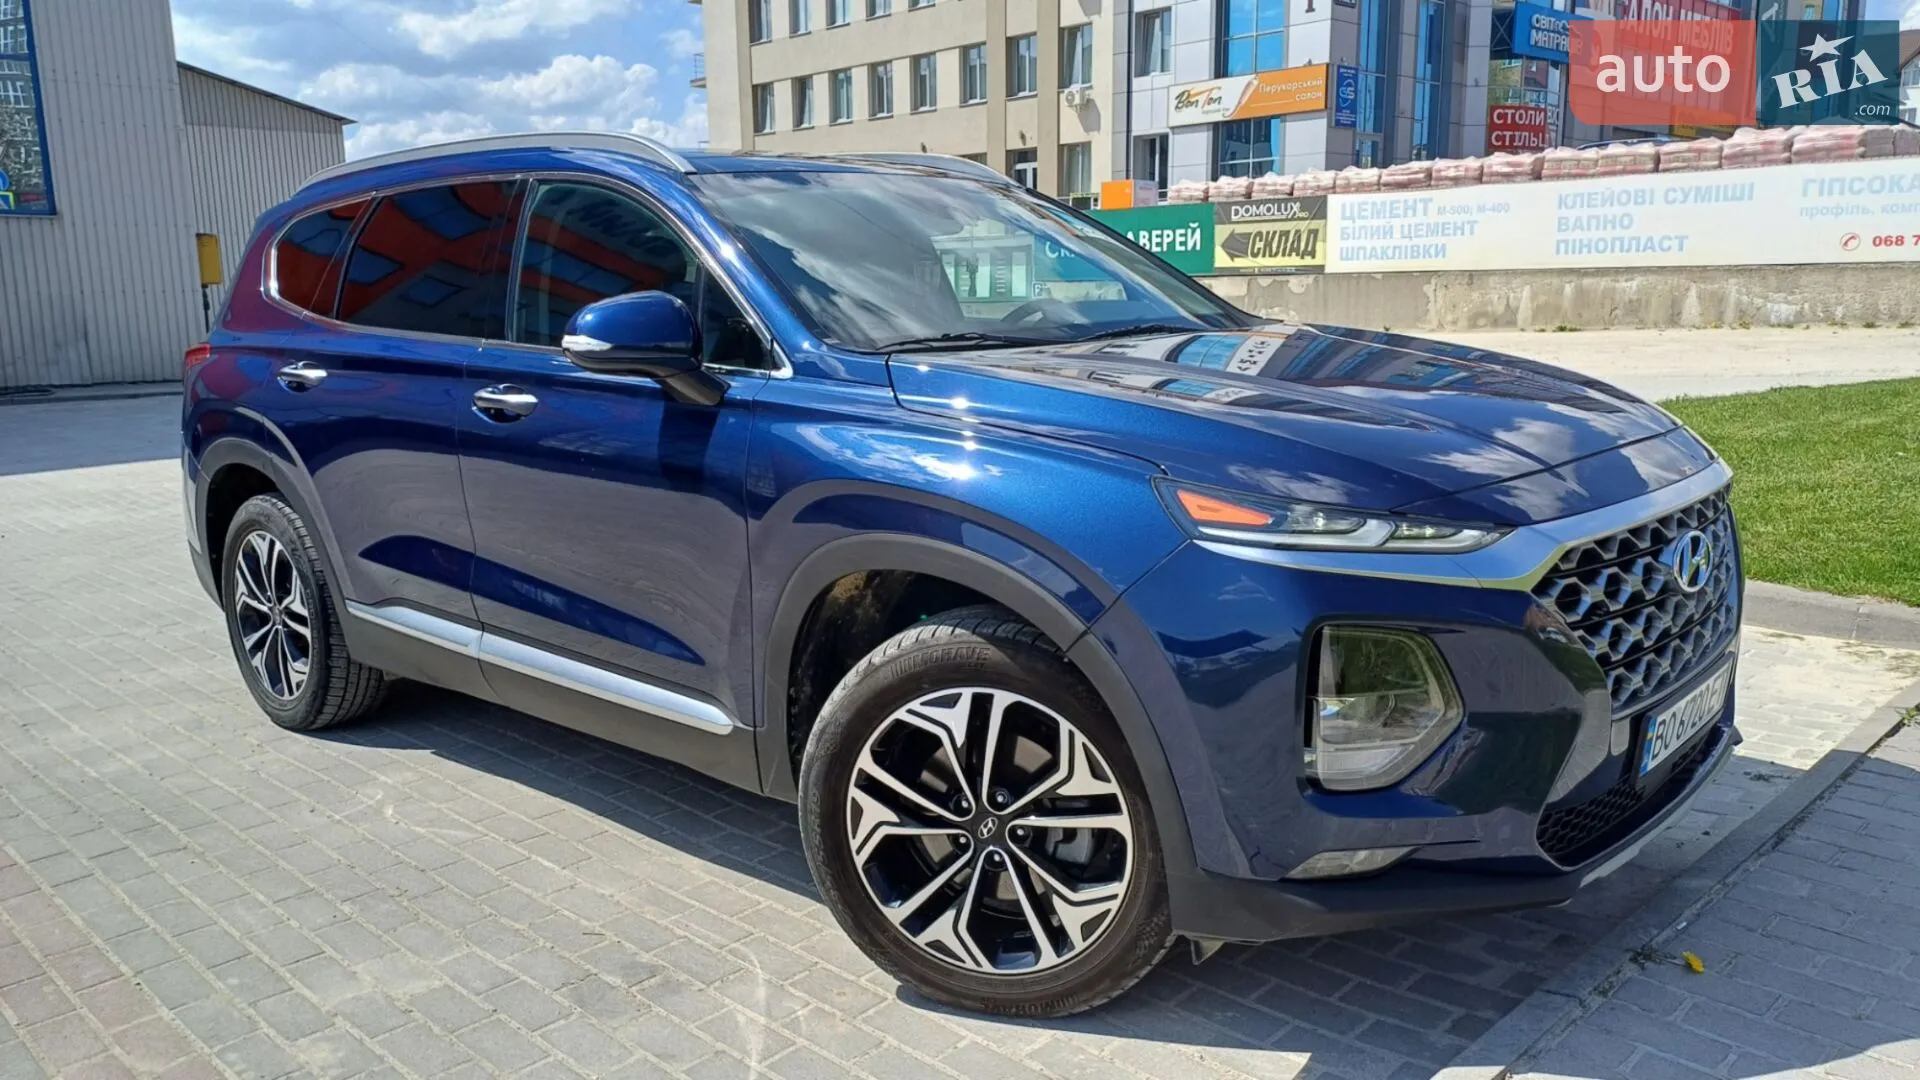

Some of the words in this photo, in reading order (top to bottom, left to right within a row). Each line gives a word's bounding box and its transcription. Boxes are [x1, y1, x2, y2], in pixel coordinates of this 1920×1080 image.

[1493, 109, 1545, 126] СТОЛИ
[1557, 186, 1655, 211] КЛЕЙОВІ
[1664, 182, 1755, 205] СУМІШІ
[1231, 202, 1301, 221] DOMOLUX
[1340, 198, 1434, 223] ЦЕМЕНТ
[1400, 220, 1479, 241] ЦЕМЕНТ
[1557, 213, 1634, 233] ВАПНО
[1249, 229, 1319, 259] СКЛАД
[1555, 235, 1689, 256] ПІНОПЛАСТ
[1872, 235, 1905, 247] 068
[1339, 244, 1447, 261] ШПАКЛІВКИ
